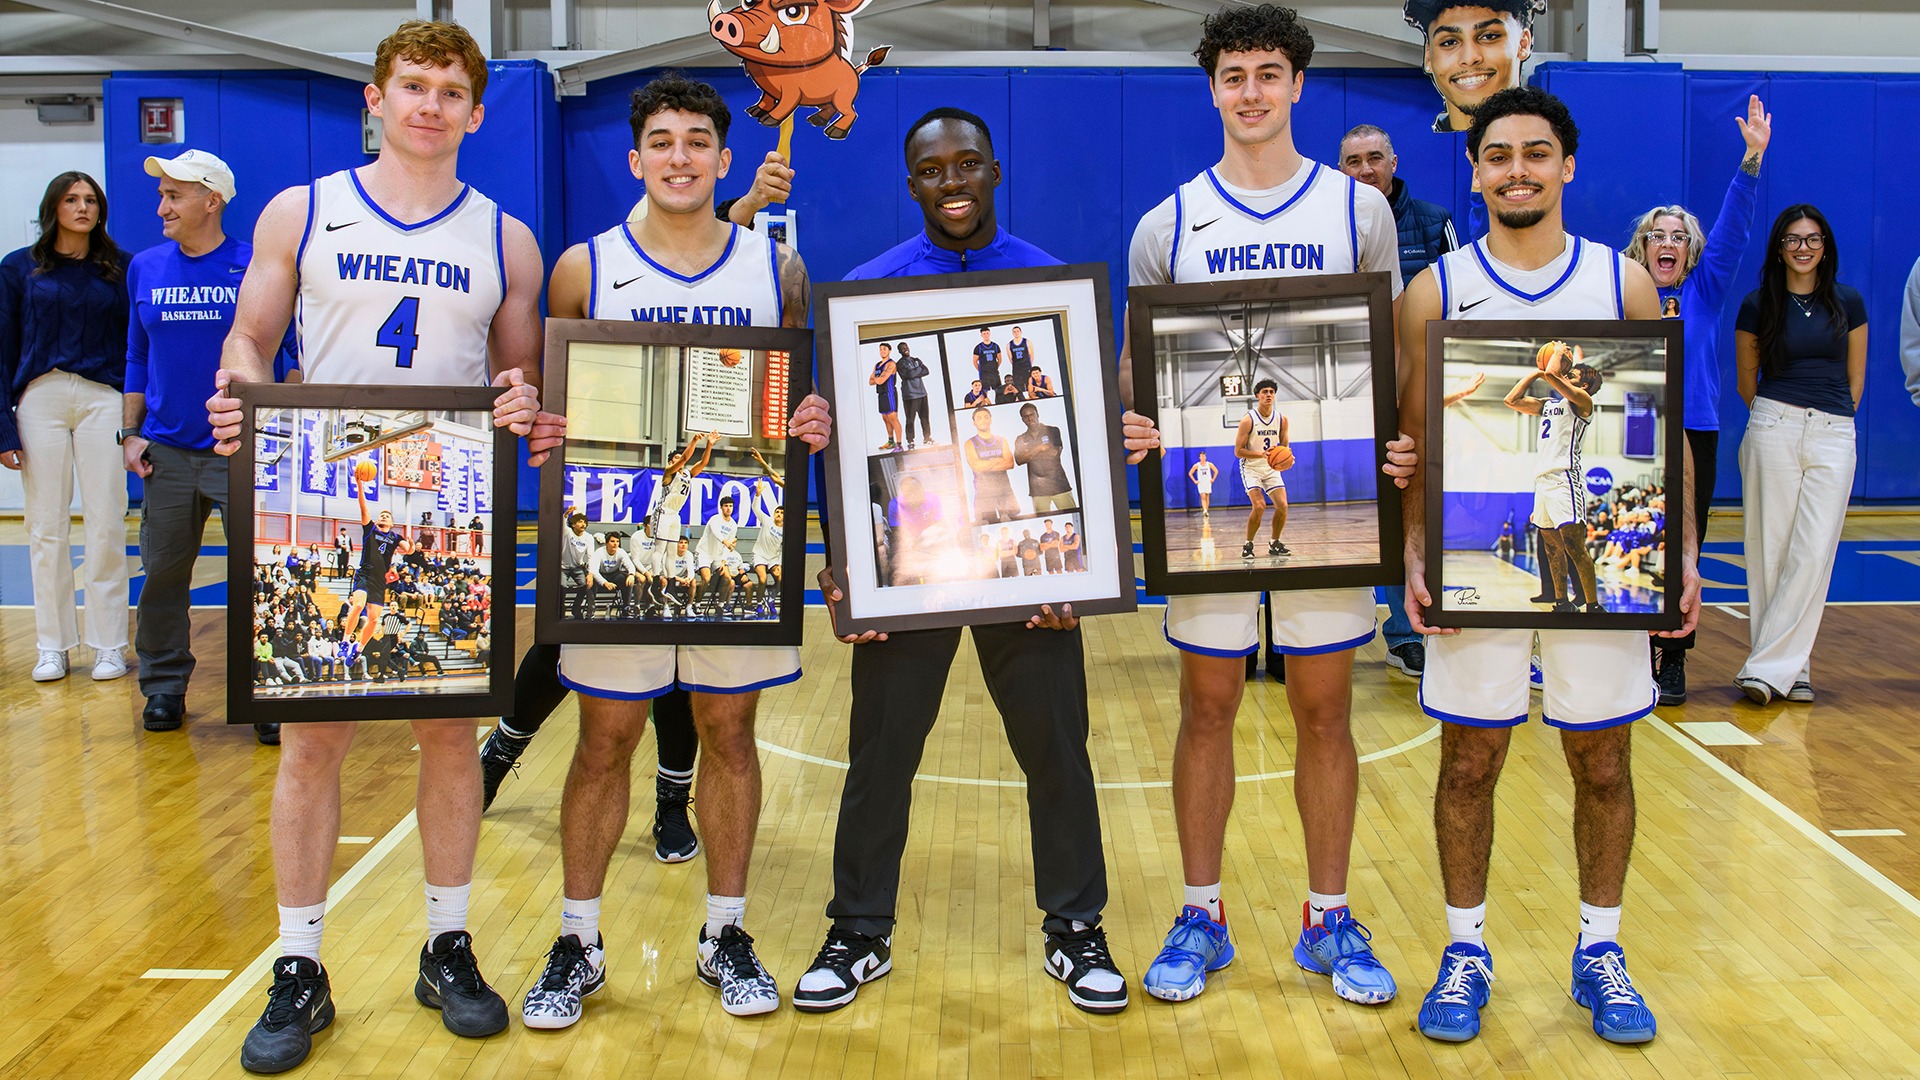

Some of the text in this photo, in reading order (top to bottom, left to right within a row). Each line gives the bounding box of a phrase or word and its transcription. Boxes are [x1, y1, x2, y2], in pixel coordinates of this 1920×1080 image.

[1205, 243, 1324, 275] WHEATON
[337, 252, 471, 294] WHEATON
[151, 286, 237, 305] WHEATON
[161, 309, 222, 321] BASKETBALL
[375, 295, 420, 369] 4
[1541, 419, 1551, 439] 2
[1263, 437, 1271, 451] 3
[1586, 475, 1613, 486] NCAA
[377, 542, 387, 555] 4
